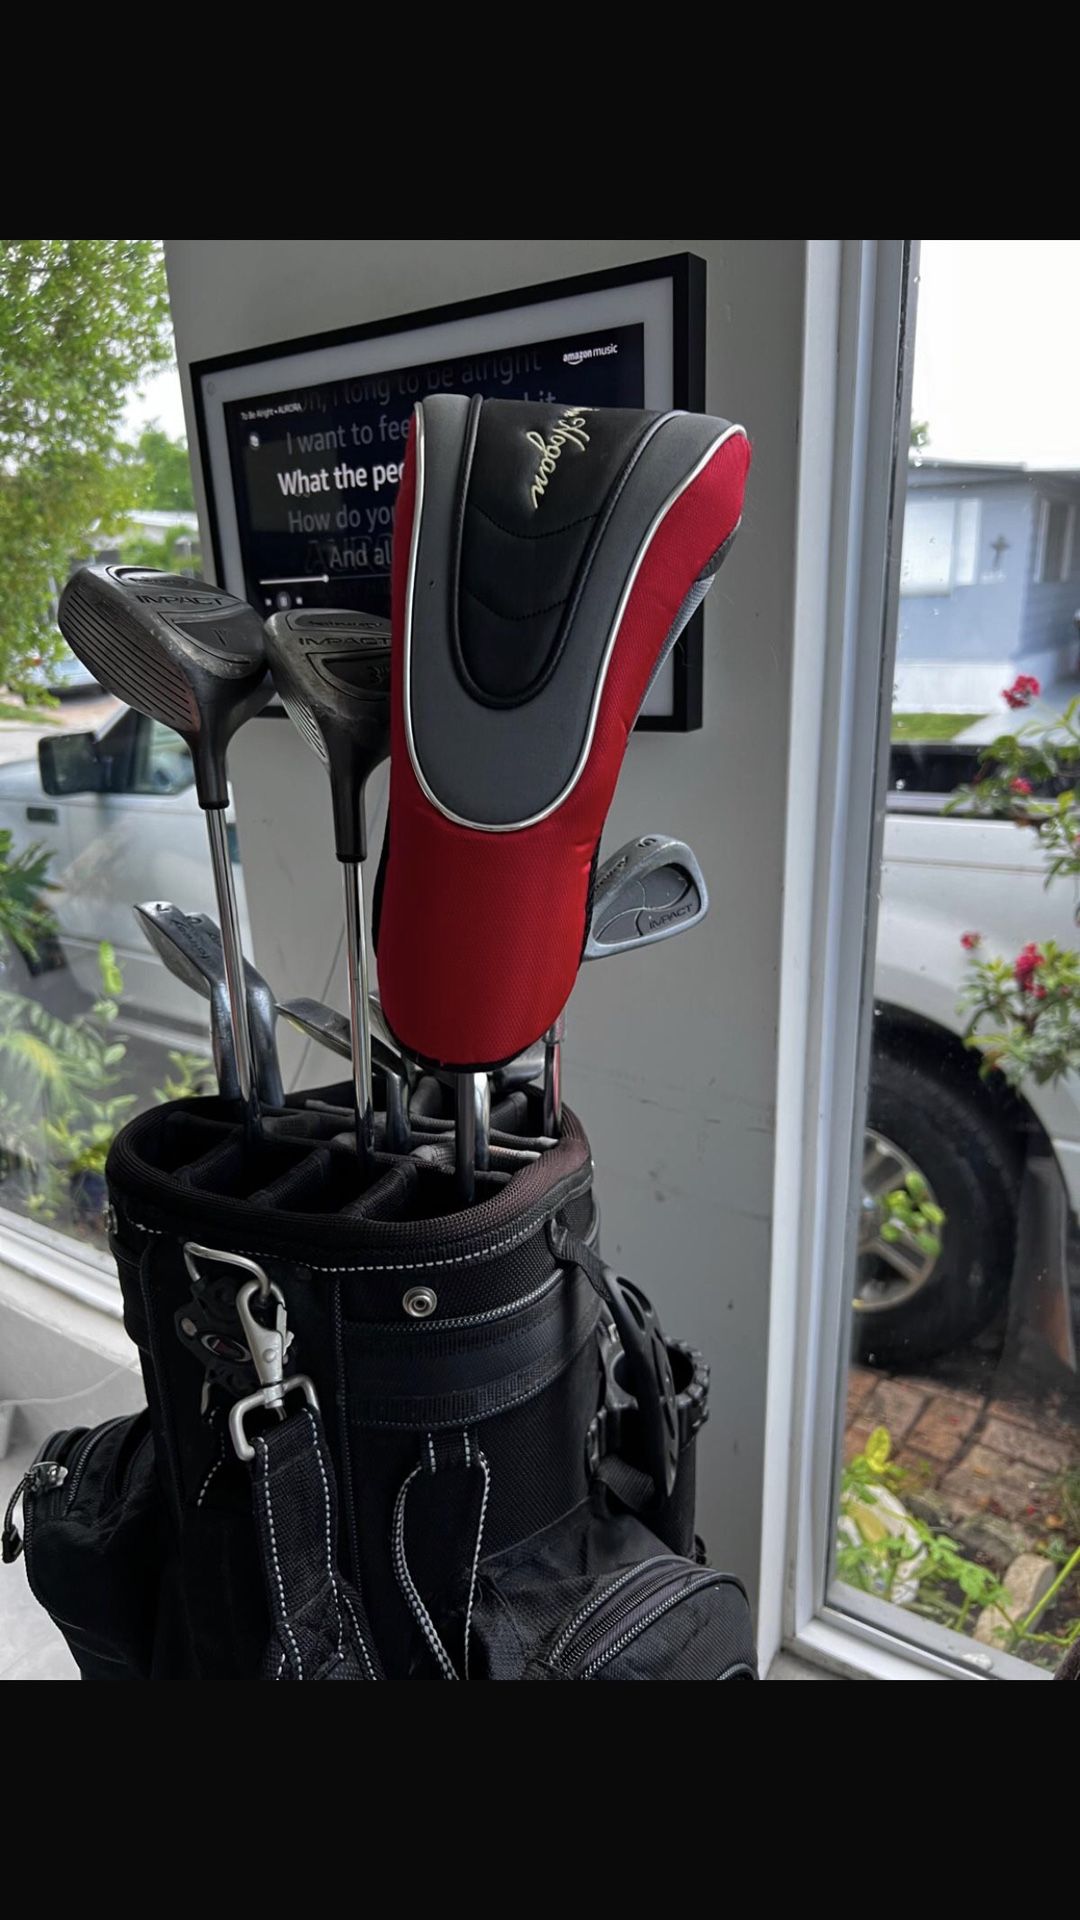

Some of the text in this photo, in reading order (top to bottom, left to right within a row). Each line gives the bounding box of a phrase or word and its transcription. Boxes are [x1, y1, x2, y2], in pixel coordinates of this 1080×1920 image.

[563, 343, 618, 365] amazon music
[343, 372, 391, 406] long
[400, 367, 420, 395] to
[461, 350, 543, 385] alright
[286, 414, 411, 455] I want to fee
[277, 468, 330, 496] What
[333, 462, 368, 490] the
[287, 504, 394, 534] How do yo
[329, 541, 369, 568] And
[136, 594, 223, 606] IMPACT
[298, 637, 390, 646] IMPACT
[648, 902, 693, 930] IMPACT
